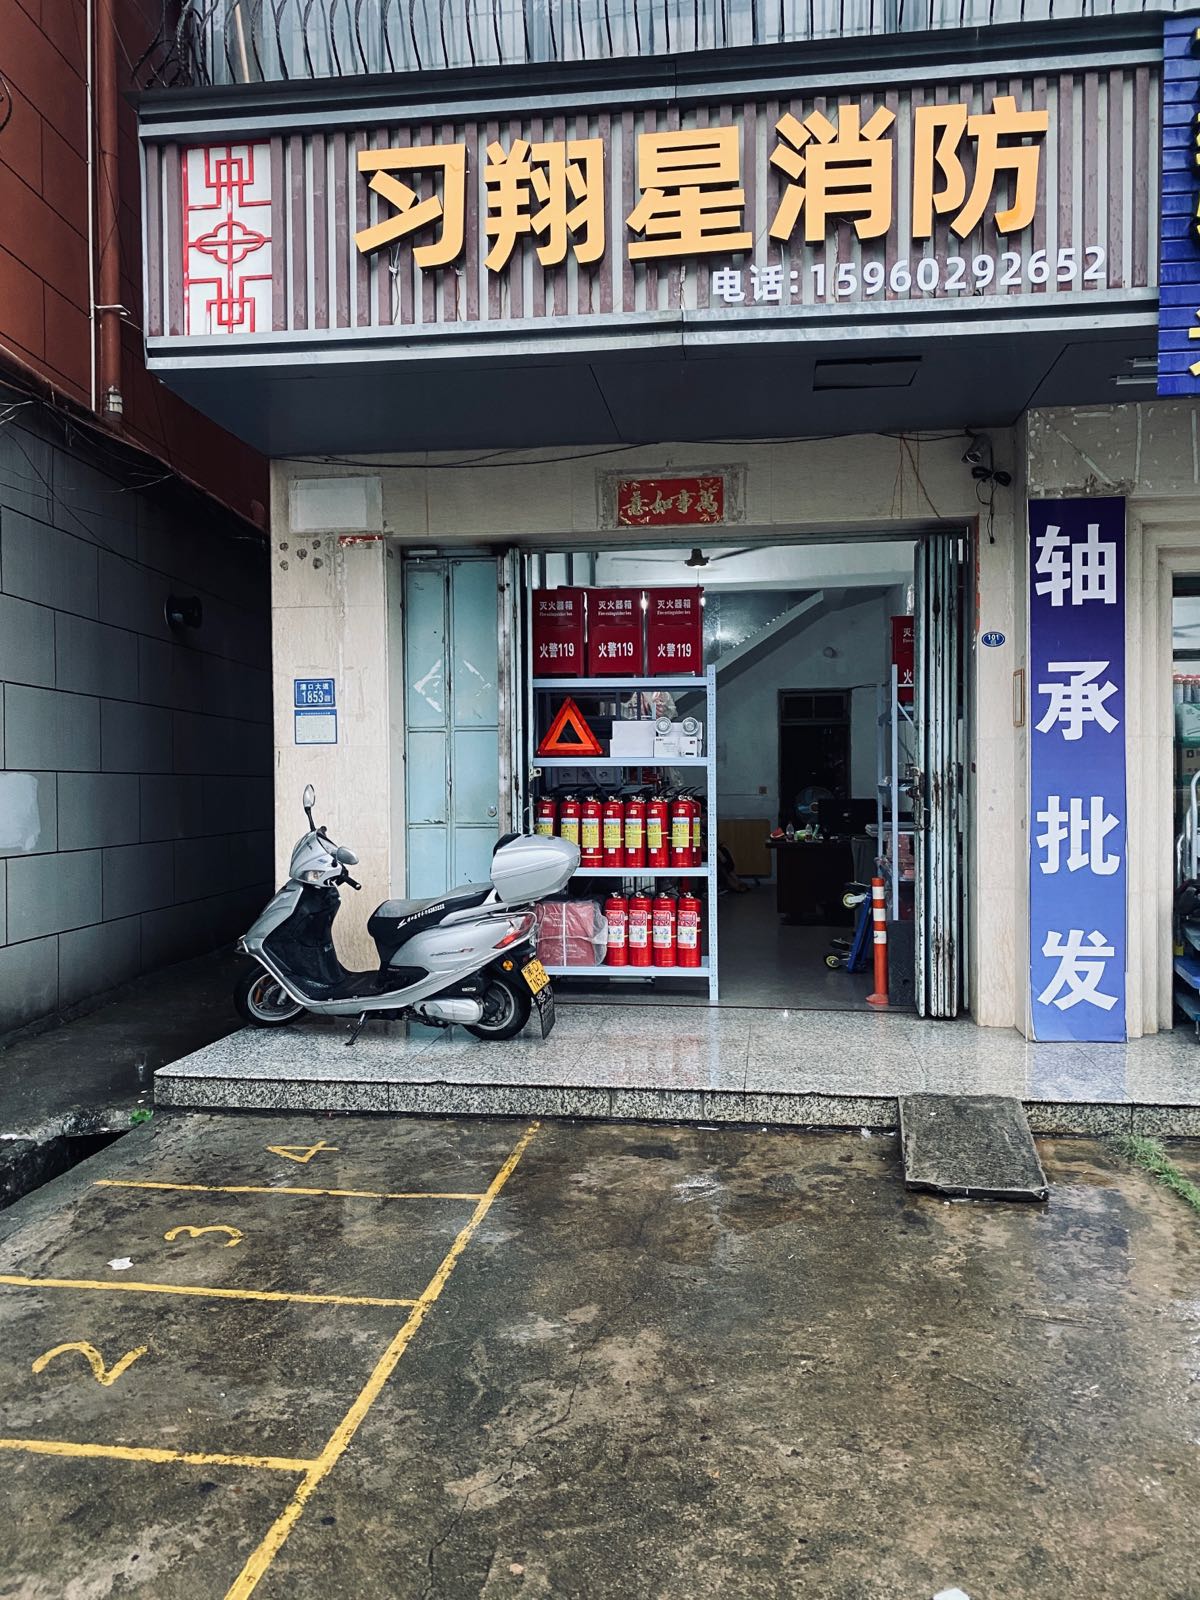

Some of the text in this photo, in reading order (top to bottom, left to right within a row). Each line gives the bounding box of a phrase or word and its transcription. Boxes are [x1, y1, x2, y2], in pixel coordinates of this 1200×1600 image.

[355, 96, 1048, 272] 习翔星消防
[598, 599, 632, 610] 灭火器箱
[657, 599, 691, 609] 灭火器箱
[539, 642, 575, 658] 火警119
[598, 641, 634, 658] 火警119
[657, 642, 692, 657] 火警119
[1035, 523, 1120, 1011] 轴承批发
[267, 1141, 339, 1163] 4
[164, 1224, 244, 1248] 3
[32, 1340, 149, 1387] 2
